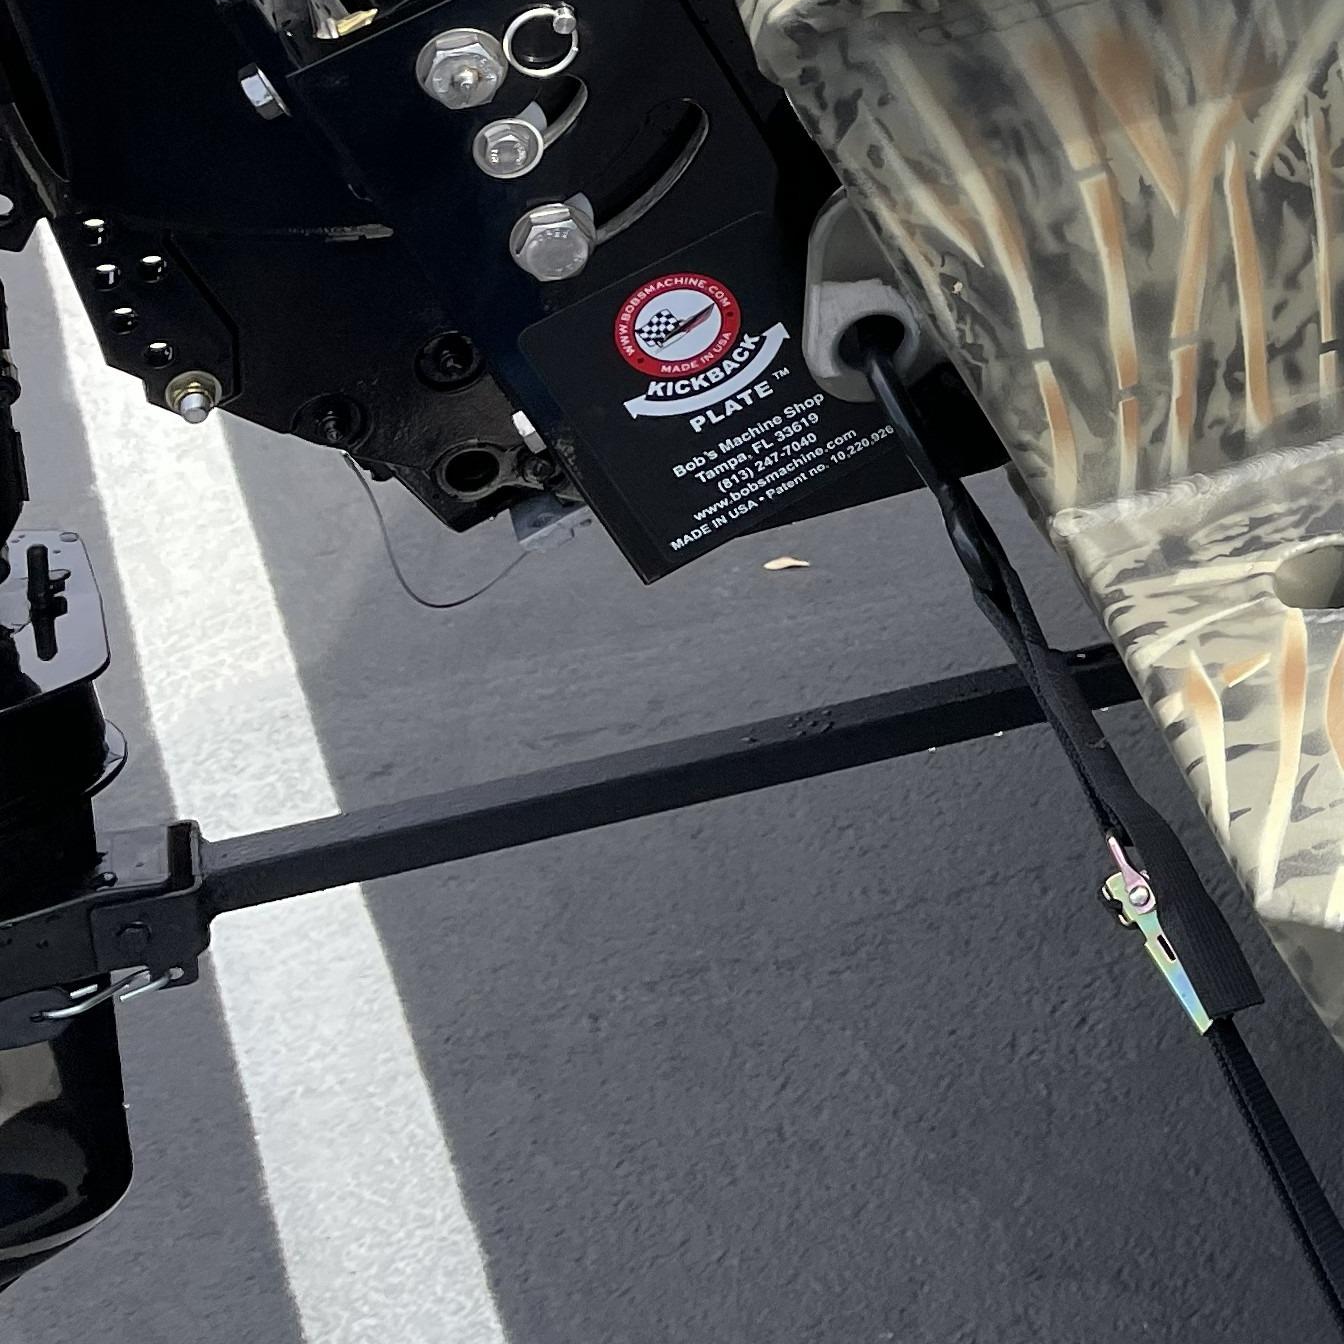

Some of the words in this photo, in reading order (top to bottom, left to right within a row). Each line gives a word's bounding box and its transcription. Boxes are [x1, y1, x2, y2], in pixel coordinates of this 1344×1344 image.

[647, 333, 760, 396] KICKBACK
[660, 362, 699, 373] MADE
[701, 352, 714, 364] IN
[714, 332, 732, 353] USA
[672, 449, 717, 477] Bob's
[718, 415, 782, 453] Machine
[783, 393, 824, 418] Shop
[689, 381, 774, 432] PLATE
[693, 430, 856, 520] www.bobsmachine.com
[694, 452, 752, 482] Tampa,
[752, 438, 774, 453] FL
[774, 412, 818, 441] 33619
[717, 466, 754, 492] (813)
[754, 432, 816, 471] 247-7040
[670, 523, 711, 550] MADE
[711, 514, 727, 528] IN
[728, 499, 758, 518] USA
[765, 472, 808, 499] Patent
[808, 463, 829, 476] no.
